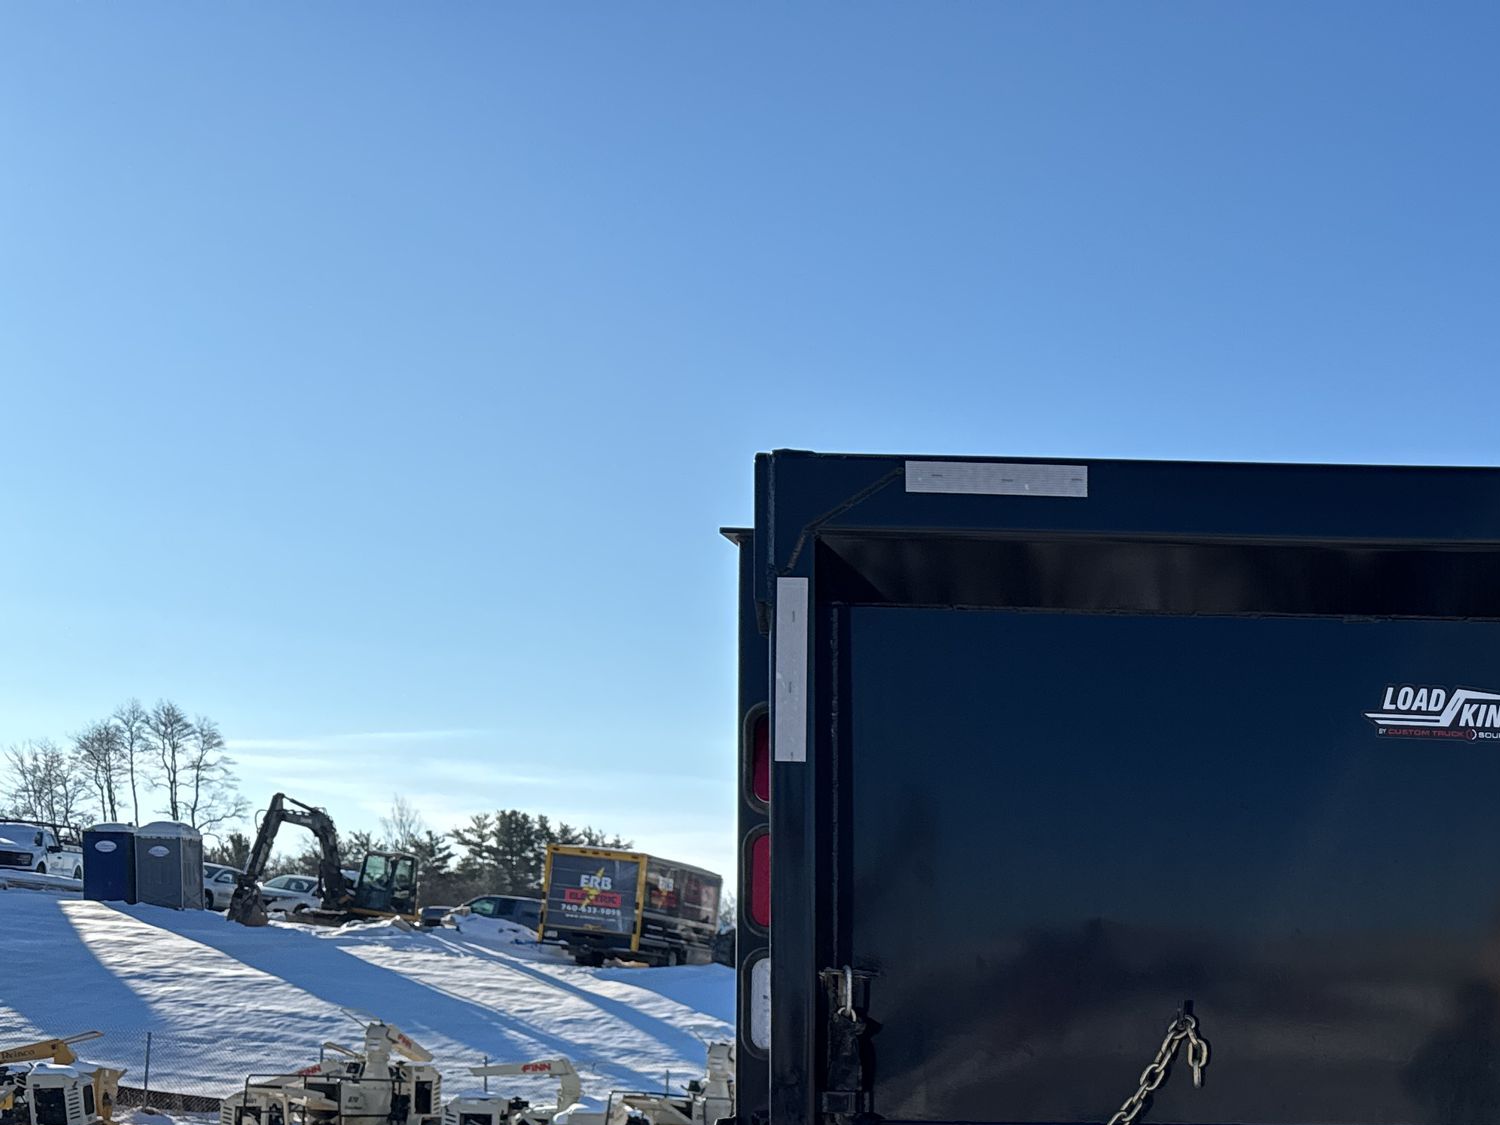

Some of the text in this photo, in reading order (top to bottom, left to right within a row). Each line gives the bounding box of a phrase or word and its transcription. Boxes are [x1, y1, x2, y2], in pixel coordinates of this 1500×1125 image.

[1383, 686, 1446, 712] LOAD
[1387, 728, 1430, 736] CUSTOM
[1432, 730, 1465, 738] TRUCK
[580, 874, 612, 890] ERB
[1, 1049, 36, 1060] Reinco
[521, 1062, 551, 1073] FINN
